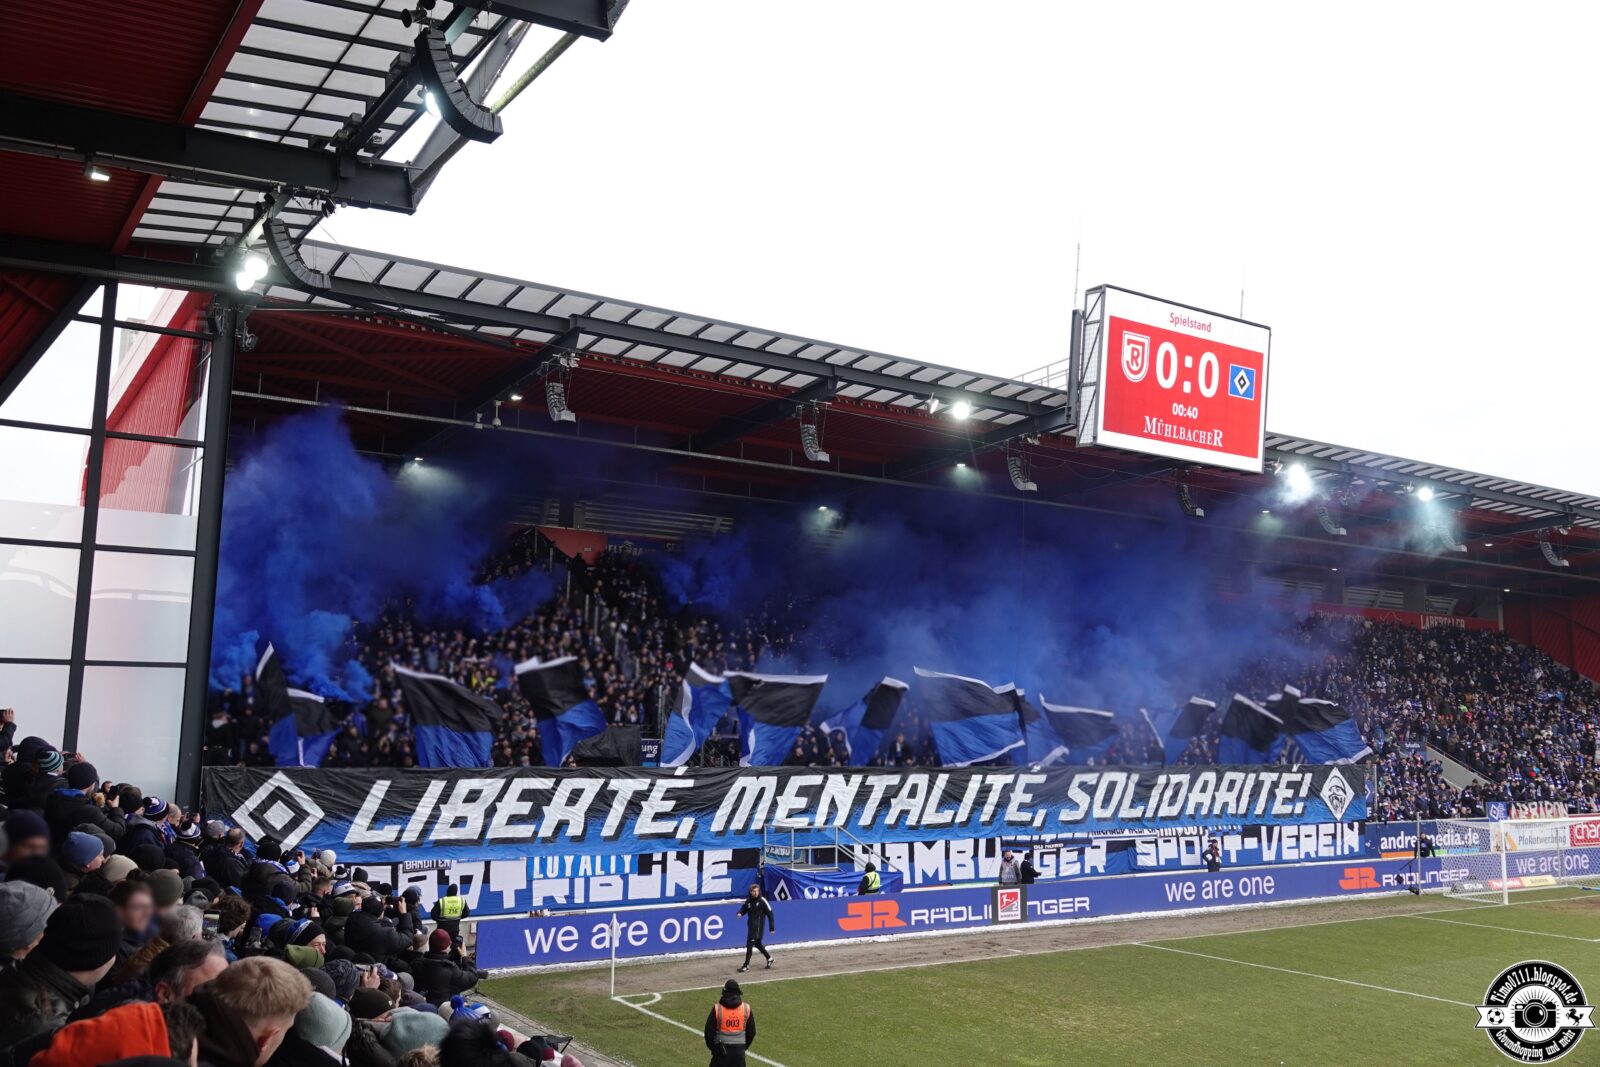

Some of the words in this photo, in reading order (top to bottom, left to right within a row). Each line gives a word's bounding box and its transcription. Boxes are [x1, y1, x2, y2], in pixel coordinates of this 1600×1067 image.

[1169, 312, 1212, 333] Spielstand
[1156, 342, 1219, 397] 0:0
[1171, 402, 1198, 420] 00:40
[1143, 415, 1223, 447] MÜHLBACHER
[343, 767, 695, 843] LIBERTÉ,
[710, 766, 1046, 833] MENTALITÉ,
[1059, 764, 1312, 823] SOLIDARITÉ!
[1574, 822, 1600, 840] cha
[1516, 857, 1536, 874] we
[1539, 855, 1559, 872] are
[1564, 853, 1590, 871] one
[1165, 881, 1196, 902] we
[1201, 876, 1234, 899] are
[1239, 872, 1276, 897] one
[524, 925, 579, 955] we
[591, 920, 649, 949] are
[659, 914, 724, 944] one
[726, 1018, 740, 1028] 003
